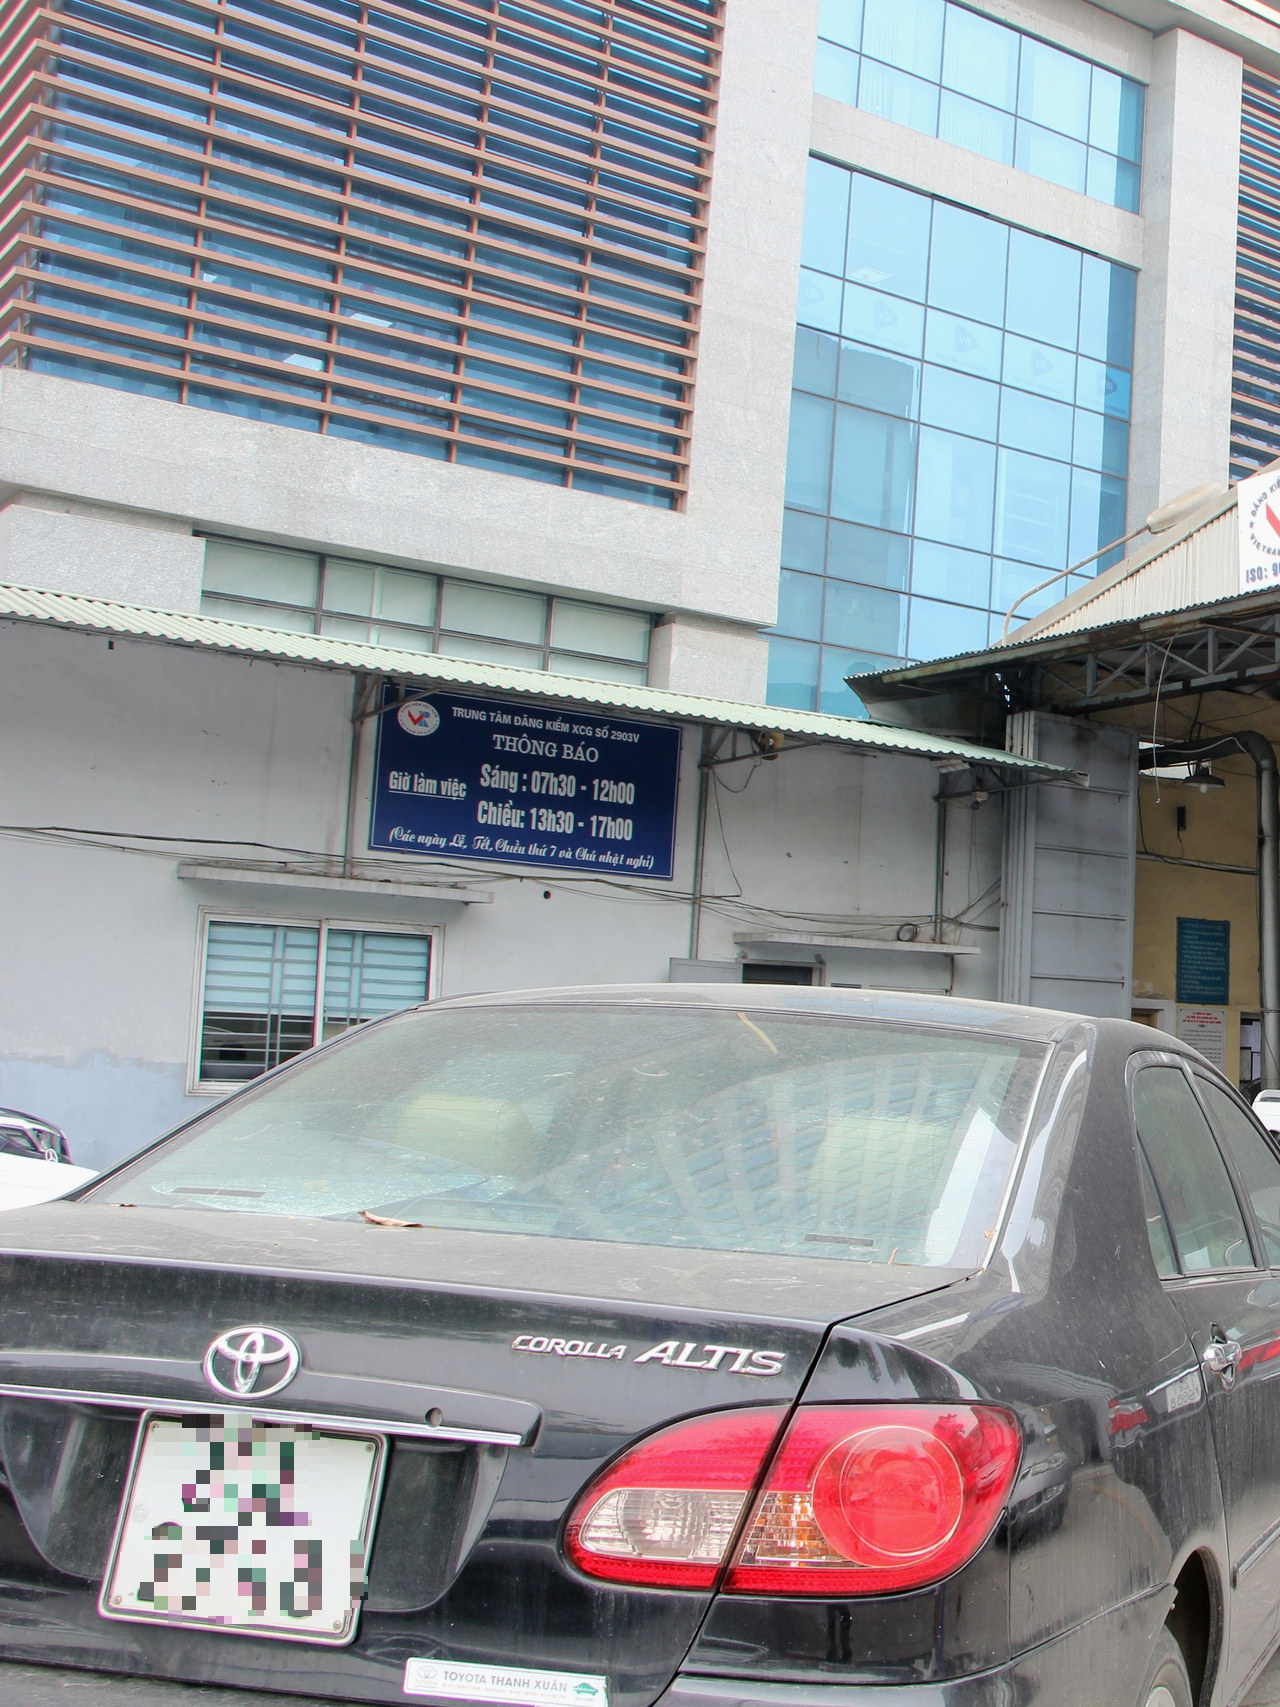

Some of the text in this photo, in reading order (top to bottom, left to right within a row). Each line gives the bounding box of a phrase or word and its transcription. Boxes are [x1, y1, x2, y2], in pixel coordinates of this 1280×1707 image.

[452, 706, 640, 743] TRUNG TÂM ĐĂNG KIỂM XCG SỐ 2903V
[492, 733, 599, 763] THÔNG BÁO
[389, 770, 467, 800] Giờ làm việc
[480, 763, 519, 794] Sáng
[530, 770, 577, 798] 07h30
[592, 778, 635, 805] 12h00
[477, 799, 525, 829] Chiều:
[529, 807, 574, 835] 13h30
[590, 815, 633, 841] 17h00
[389, 826, 416, 843] (Các
[417, 833, 447, 849] ngày
[527, 842, 548, 857] thứ
[549, 845, 557, 857] 7
[558, 847, 572, 859] và
[598, 850, 624, 866] nhật
[511, 1334, 787, 1377] COROLLA ALTIS
[415, 1679, 438, 1687] TOYOTA
[443, 1670, 487, 1685] TOYOTA
[490, 1675, 530, 1689] THANH
[534, 1679, 568, 1693] XUÂN
